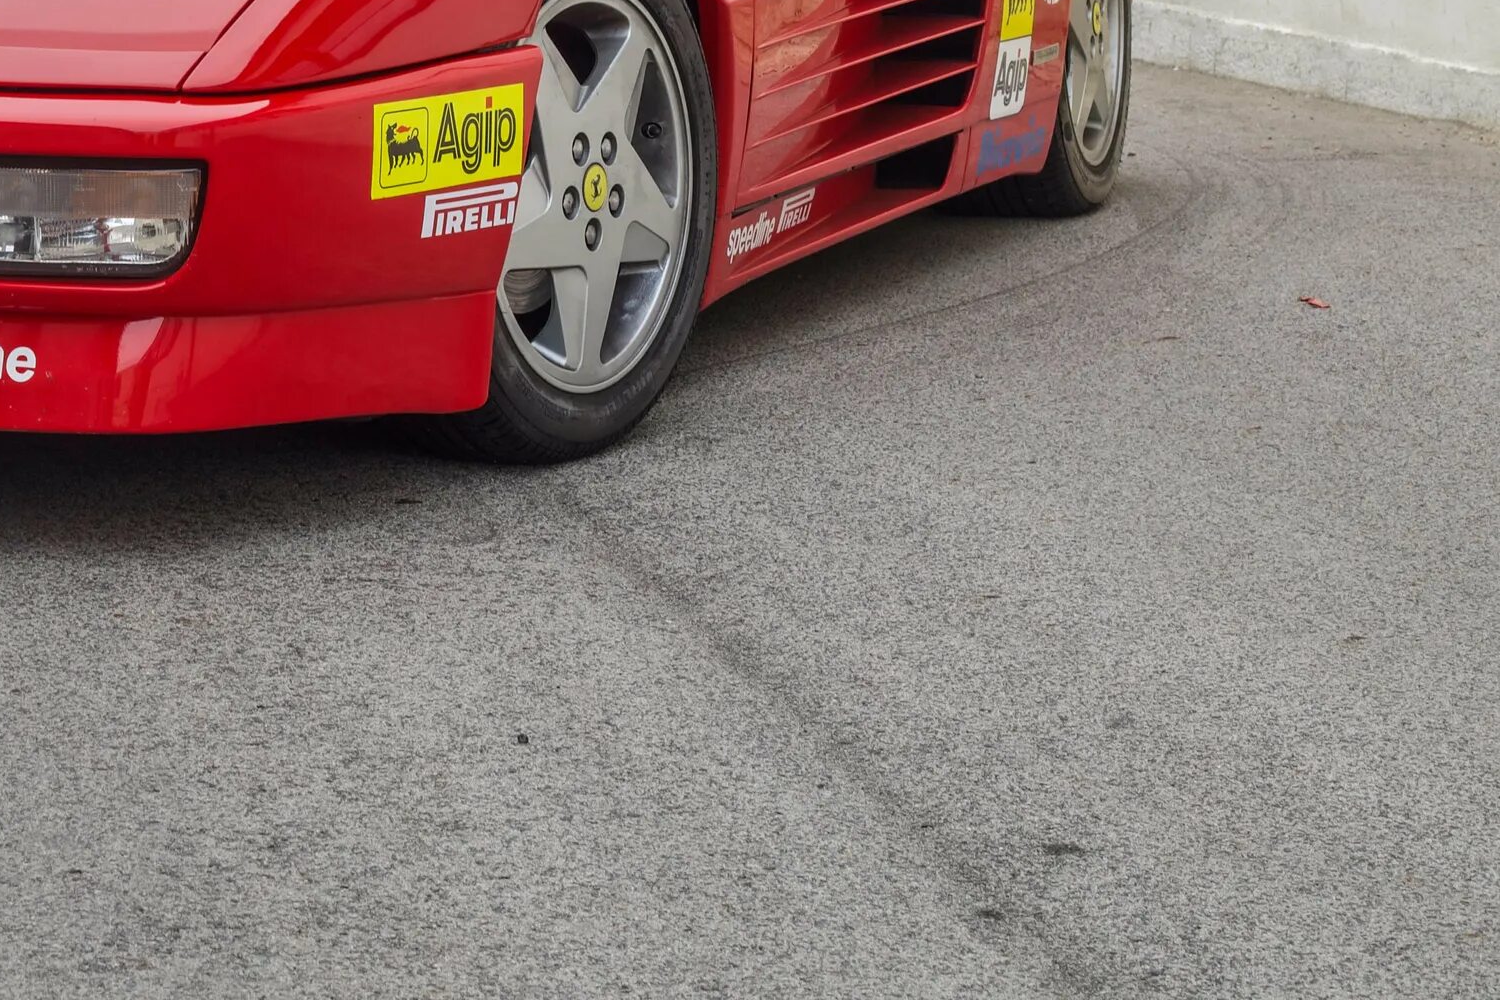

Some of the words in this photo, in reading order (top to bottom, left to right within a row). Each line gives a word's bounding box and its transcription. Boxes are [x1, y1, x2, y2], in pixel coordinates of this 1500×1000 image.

[994, 48, 1027, 106] Agip
[433, 96, 516, 174] Agip
[420, 181, 519, 239] PIRELLI
[726, 211, 776, 264] speedline
[776, 187, 816, 233] PIRELLI
